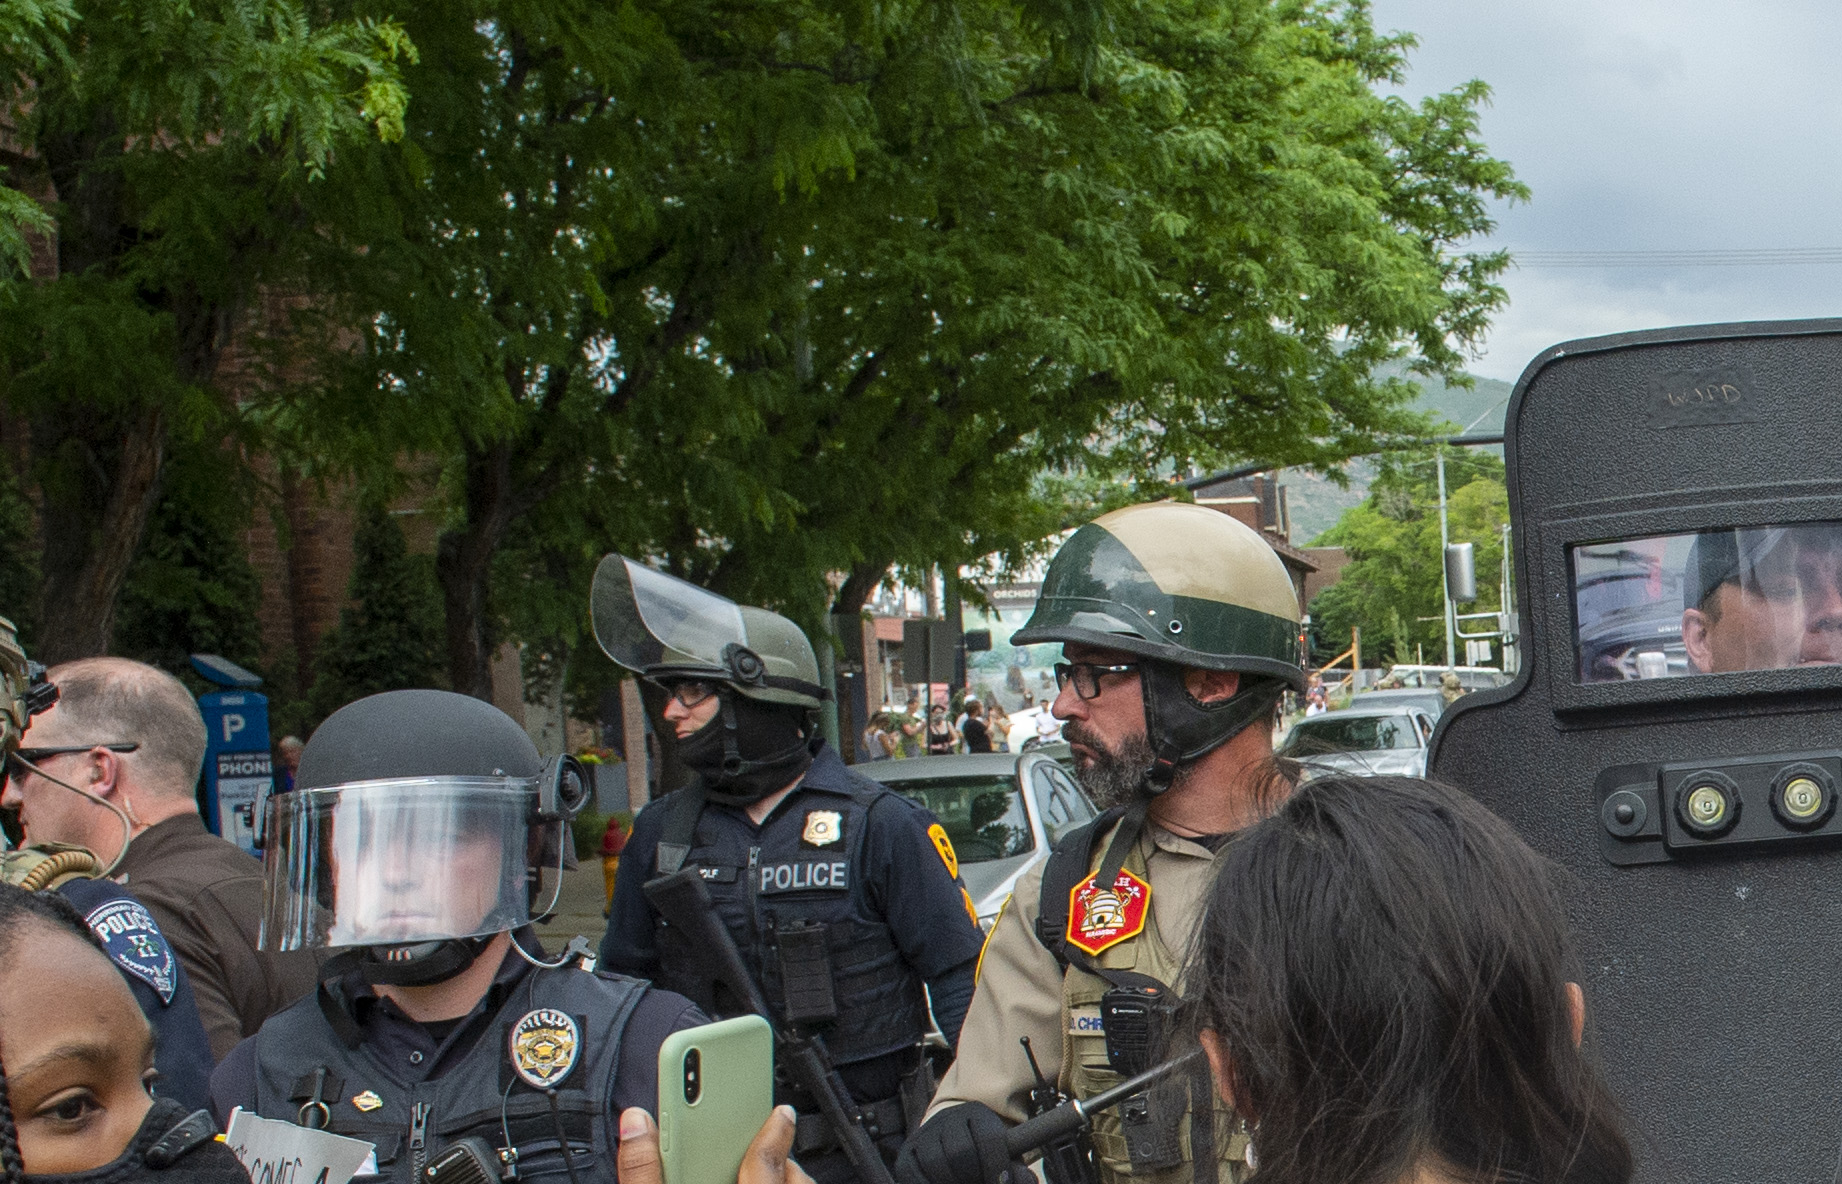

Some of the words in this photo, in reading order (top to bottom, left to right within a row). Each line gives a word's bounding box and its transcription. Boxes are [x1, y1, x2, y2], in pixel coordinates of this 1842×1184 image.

[993, 589, 1037, 599] ORCHIDS
[221, 713, 246, 743] P
[761, 862, 846, 891] POLICE
[95, 910, 158, 943] POLICE
